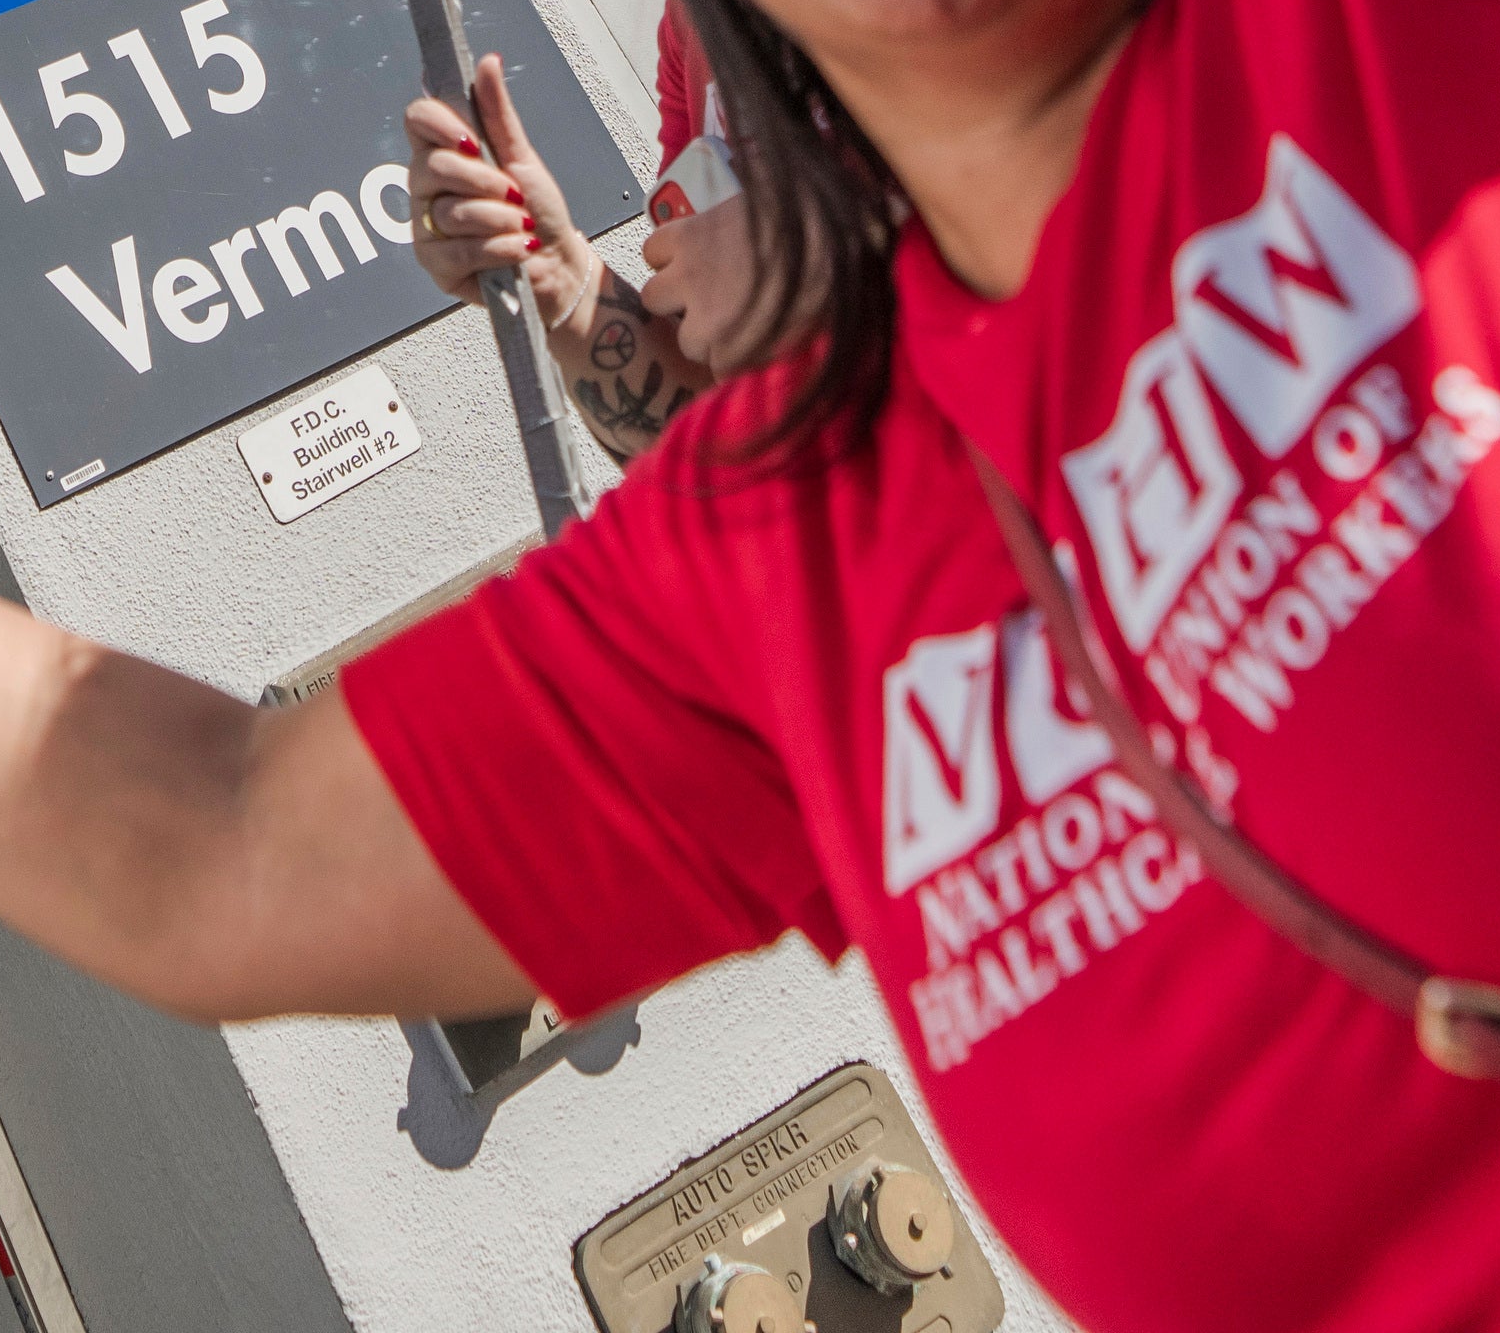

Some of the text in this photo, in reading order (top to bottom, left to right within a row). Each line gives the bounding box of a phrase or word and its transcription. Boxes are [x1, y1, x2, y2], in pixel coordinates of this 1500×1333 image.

[290, 400, 347, 438] F.D.C.
[293, 418, 370, 469] Building
[291, 430, 400, 502] Stairwell #2
[1145, 468, 1322, 724] UNION
[1312, 363, 1414, 482] OF
[648, 1242, 689, 1284] FIRE
[751, 1132, 861, 1214] CONNECTION
[670, 1121, 810, 1227] AUTO SPKR
